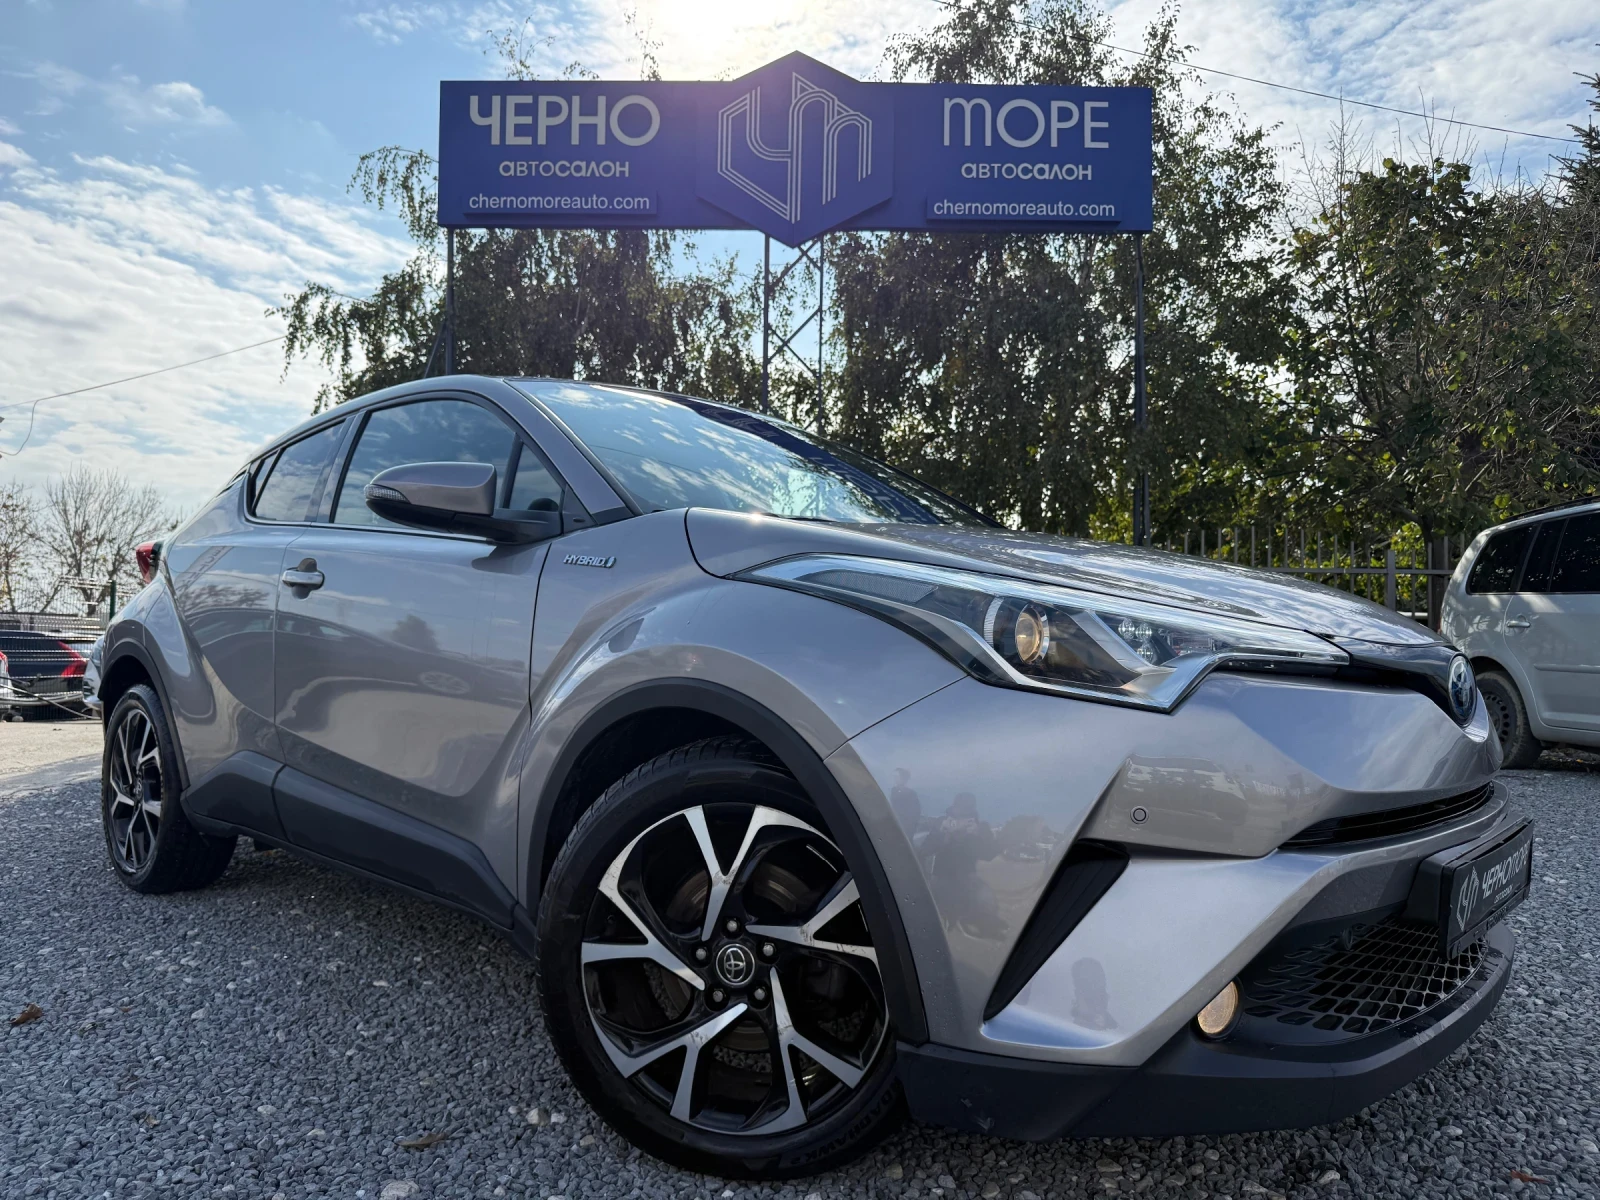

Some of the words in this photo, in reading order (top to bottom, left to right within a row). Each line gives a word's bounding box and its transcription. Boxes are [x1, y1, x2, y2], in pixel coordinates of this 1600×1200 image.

[469, 94, 661, 147] ЧЕРНО
[499, 160, 630, 177] автосалон
[961, 162, 1093, 181] автосалон
[469, 193, 650, 210] chernomoreauto.com
[933, 199, 1116, 217] chernomoreauto.com
[563, 554, 606, 567] HYBRID
